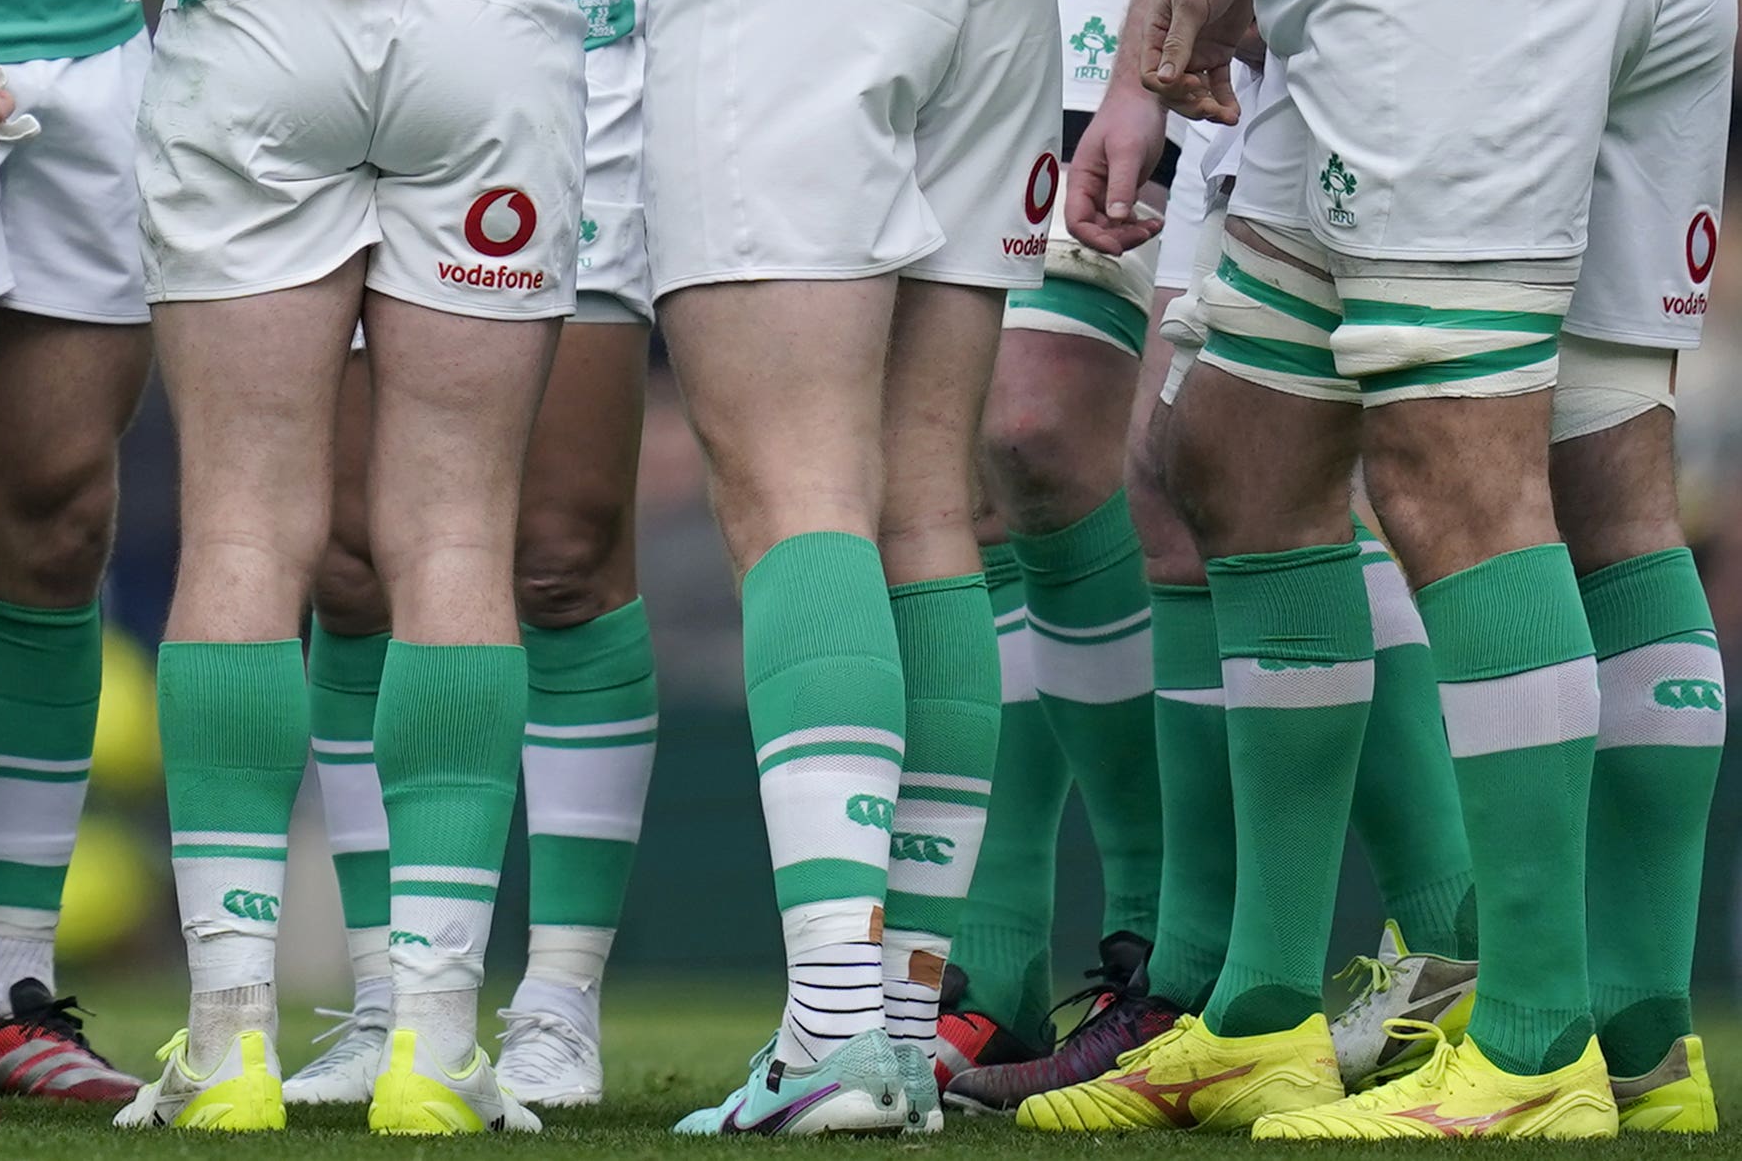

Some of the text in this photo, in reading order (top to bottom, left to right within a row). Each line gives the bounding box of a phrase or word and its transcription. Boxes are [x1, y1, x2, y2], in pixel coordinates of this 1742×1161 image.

[1075, 66, 1111, 80] IRFU
[1328, 208, 1355, 225] IRFU
[438, 261, 544, 290] vodafone
